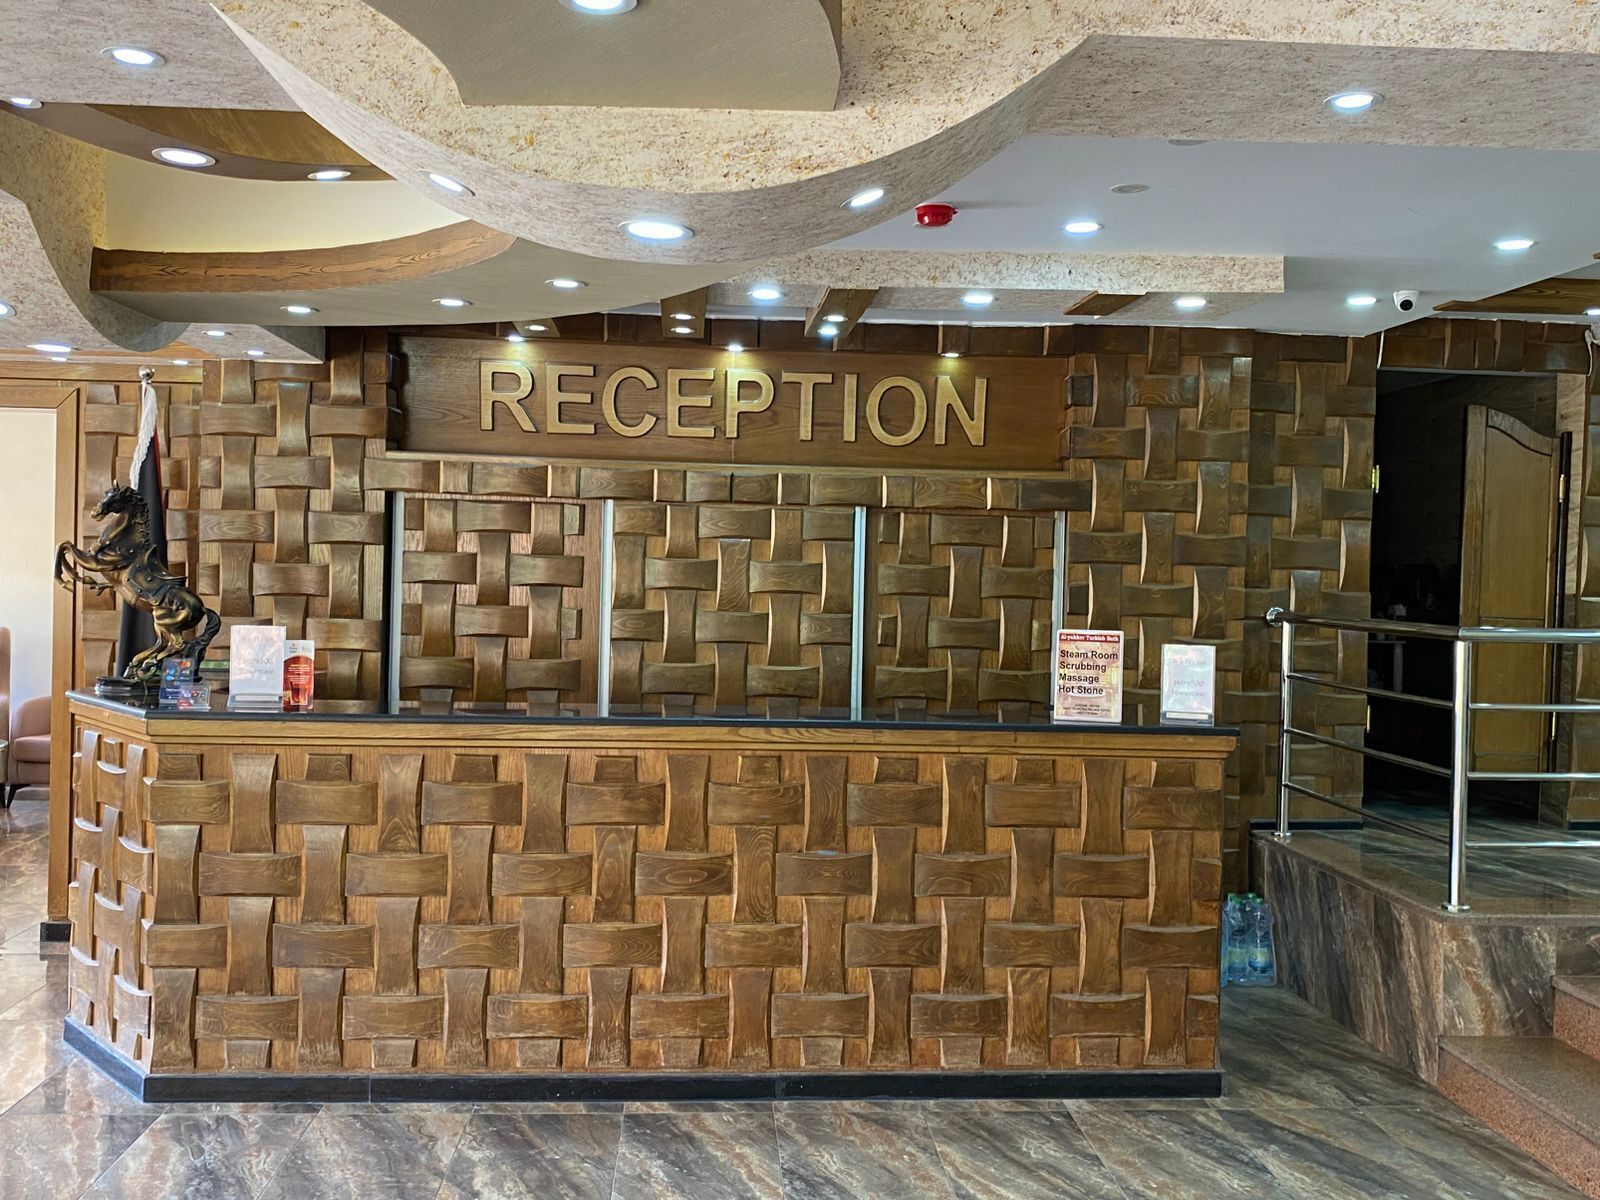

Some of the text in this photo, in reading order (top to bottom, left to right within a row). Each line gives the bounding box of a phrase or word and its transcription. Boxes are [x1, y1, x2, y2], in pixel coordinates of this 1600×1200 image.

[478, 361, 988, 447] RECEPTION
[1060, 649, 1118, 660] Steam Room
[1059, 661, 1107, 673] Scrubbing
[1059, 673, 1100, 685] Massage
[1058, 684, 1104, 695] Hot Stone
